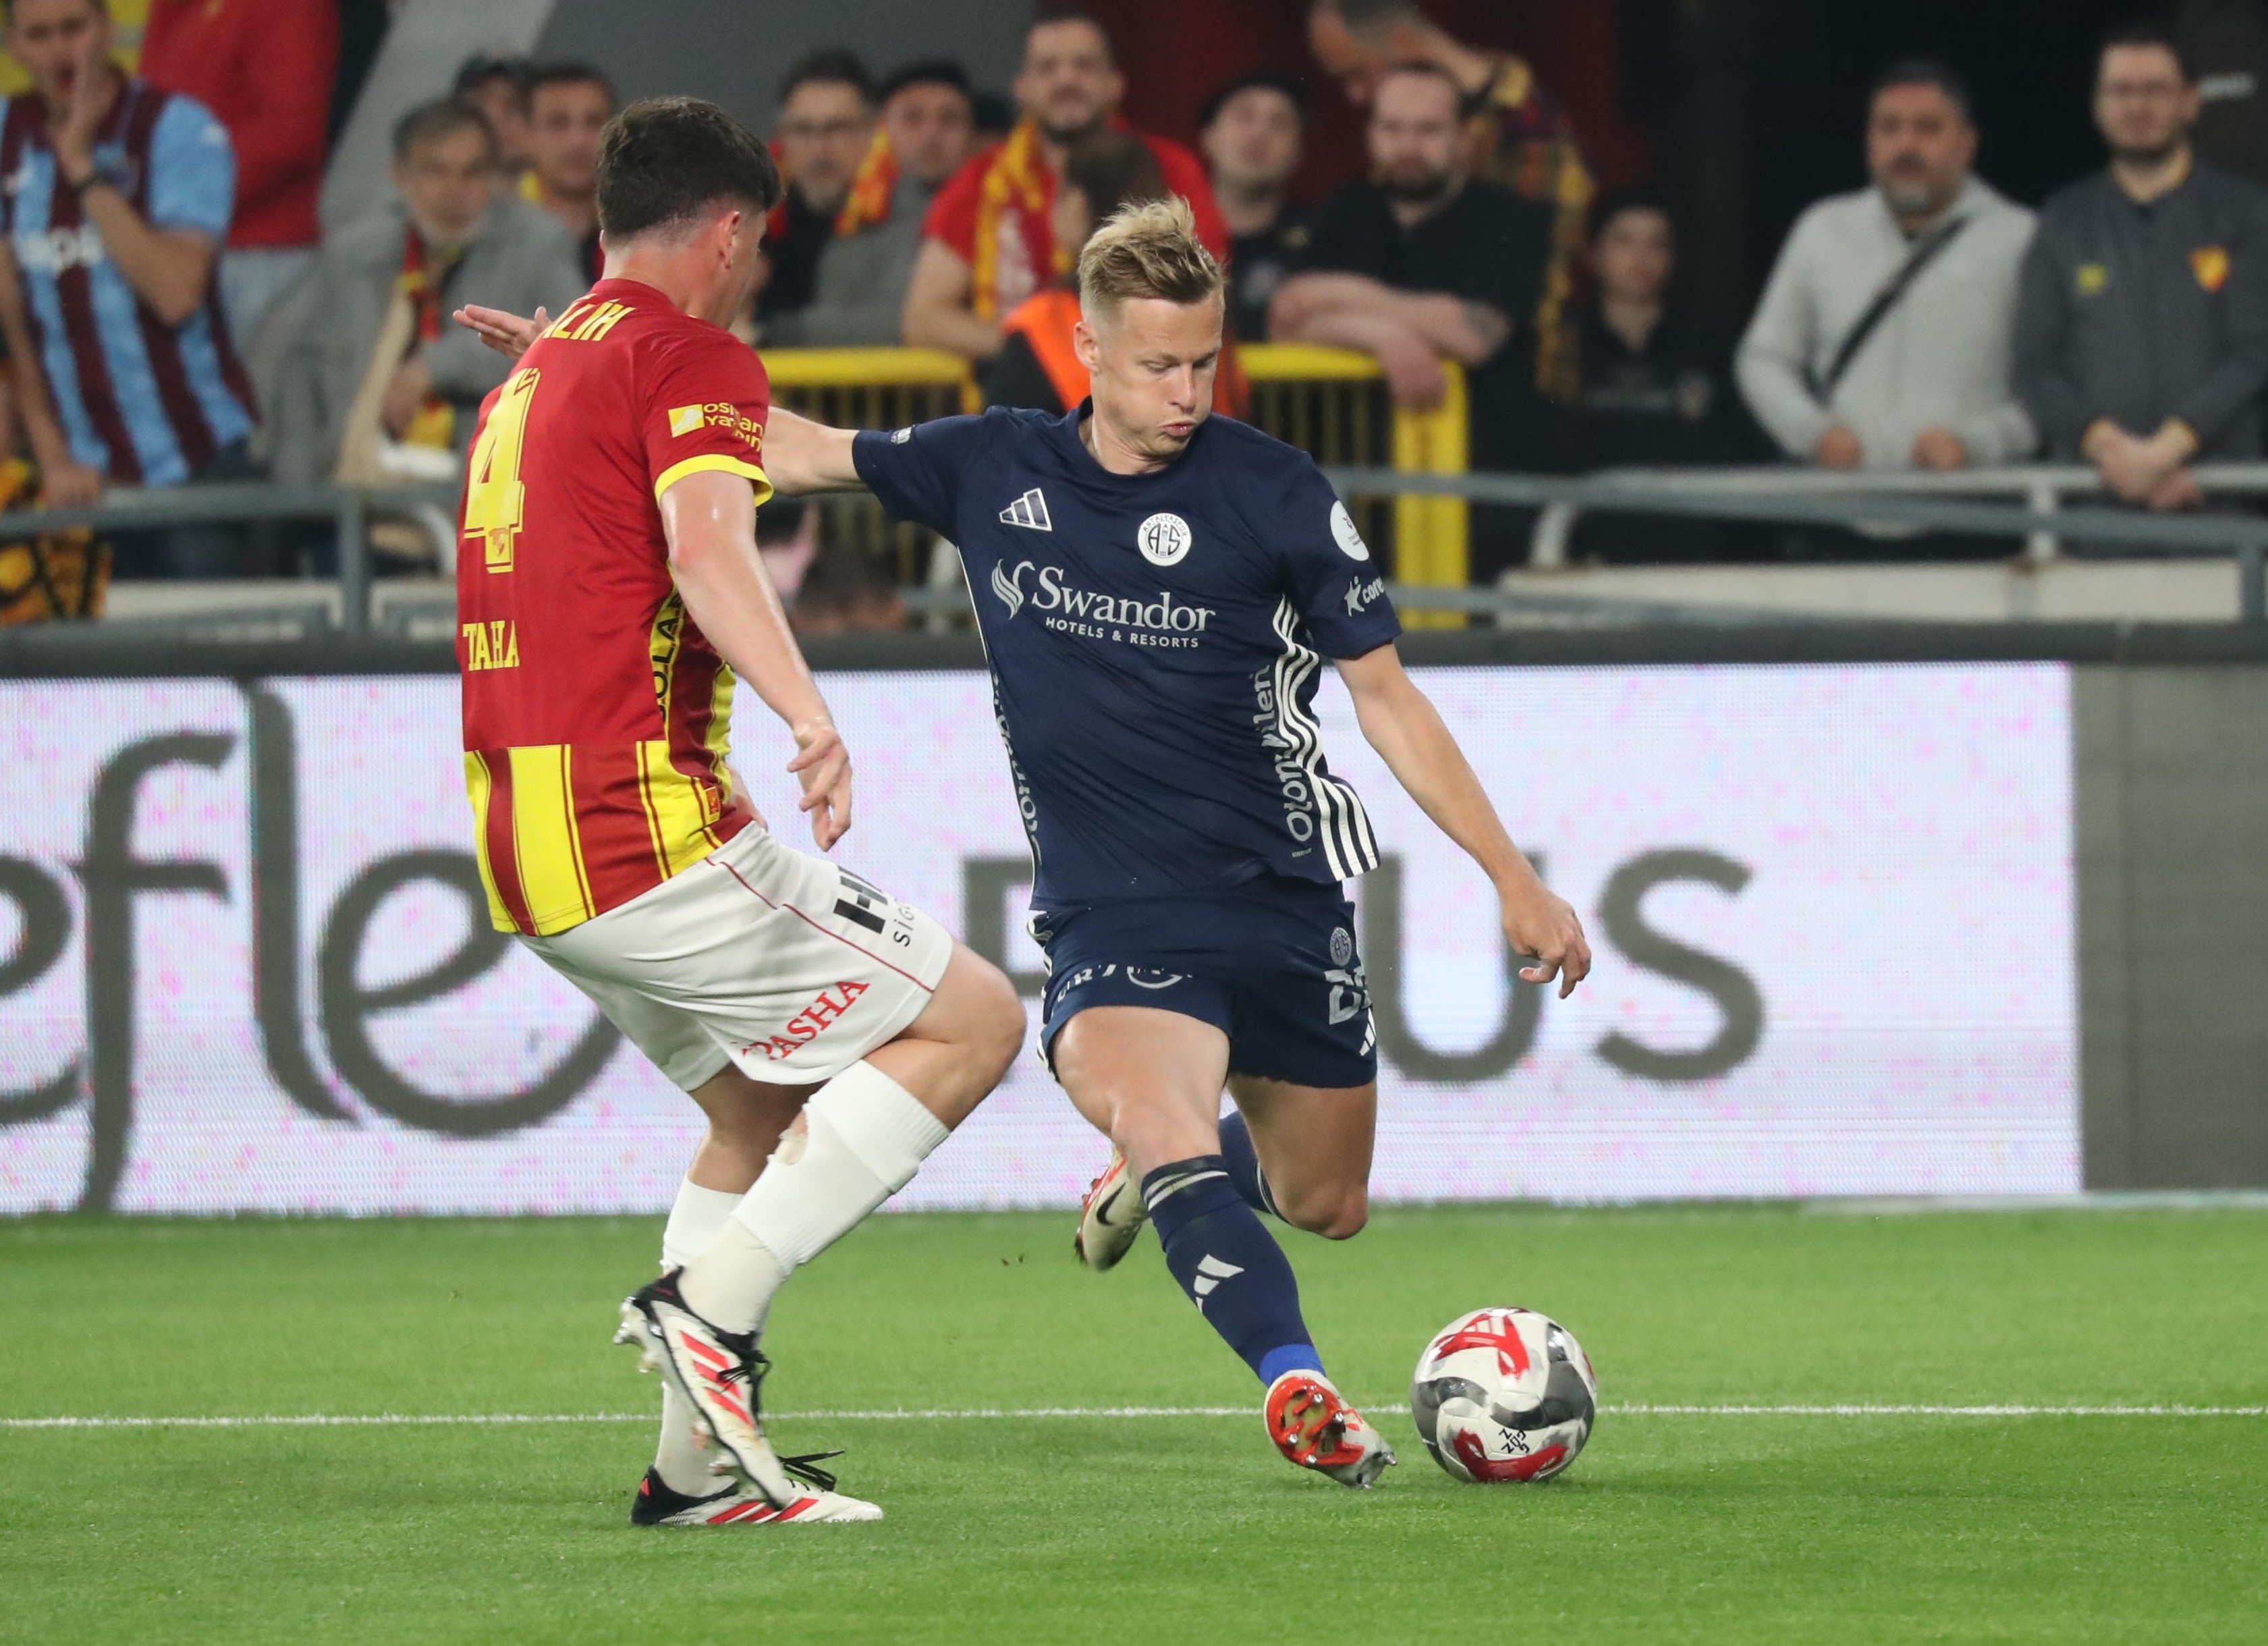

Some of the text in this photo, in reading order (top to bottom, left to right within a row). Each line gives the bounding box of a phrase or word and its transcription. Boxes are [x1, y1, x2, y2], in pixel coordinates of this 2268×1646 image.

[464, 367, 541, 574] 4
[1032, 566, 1216, 632] Swandor
[462, 620, 520, 671] TAHA
[1045, 616, 1199, 649] HOTELS & RESORTS
[961, 845, 1767, 1085] PUS
